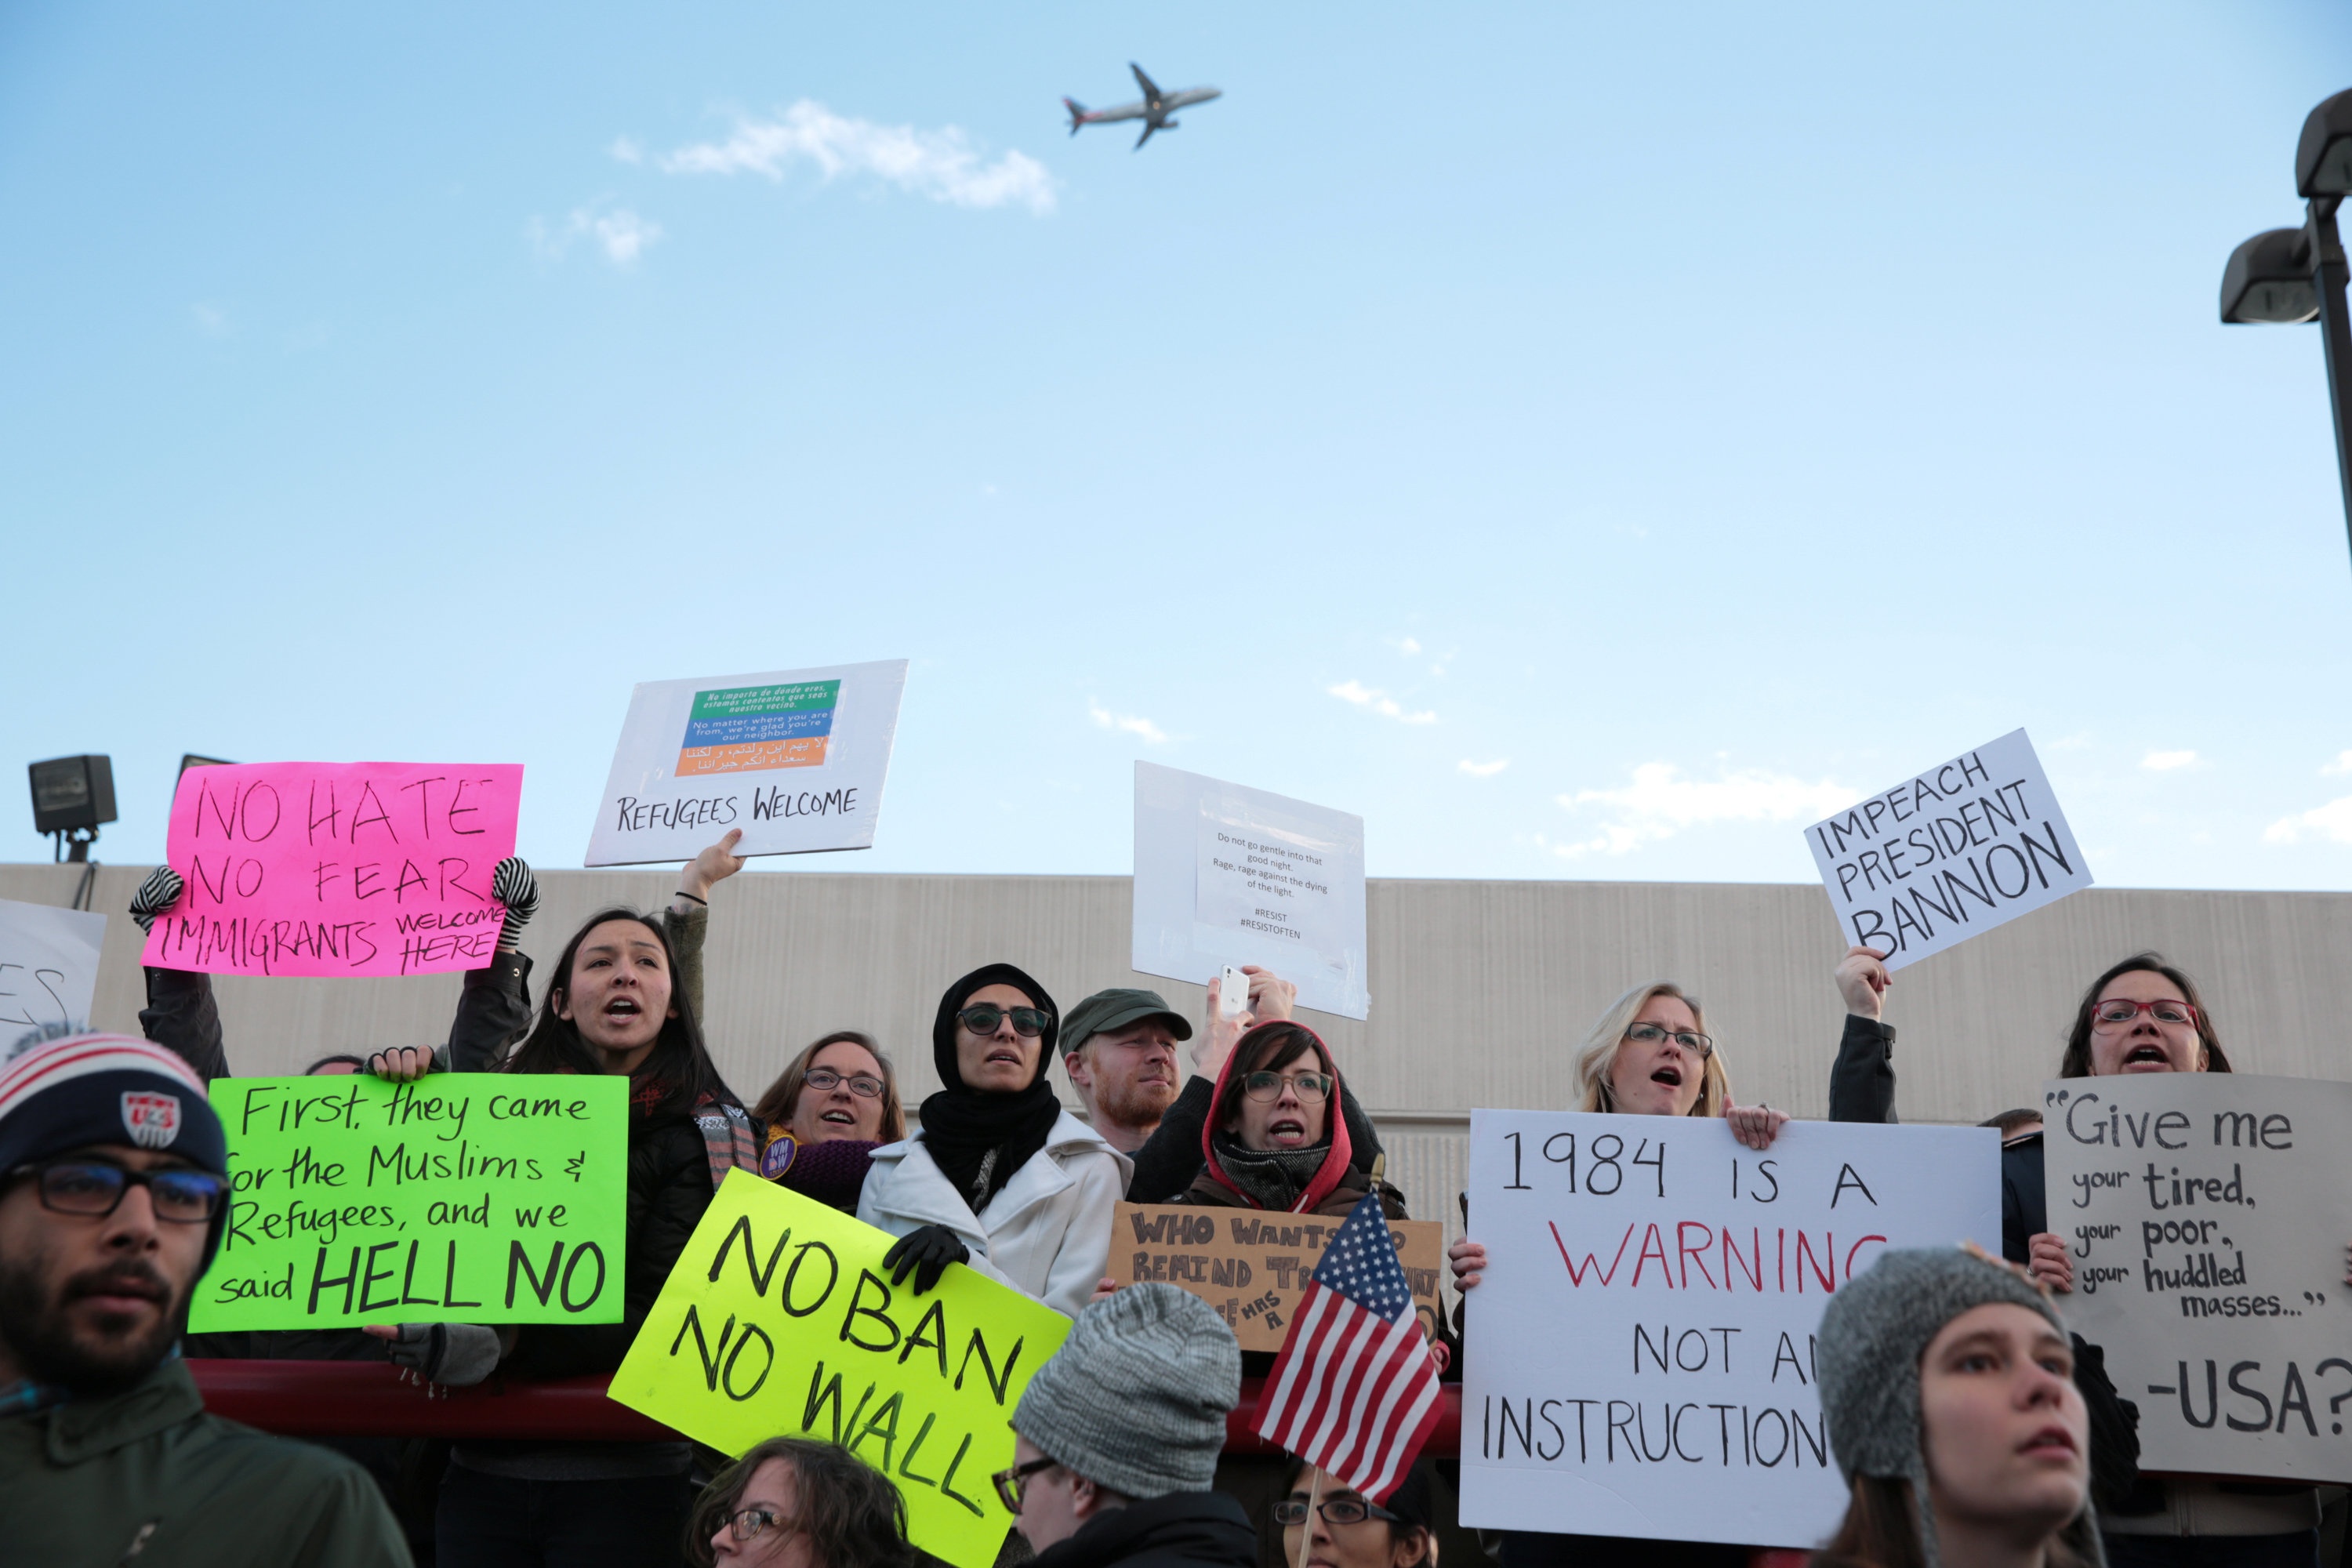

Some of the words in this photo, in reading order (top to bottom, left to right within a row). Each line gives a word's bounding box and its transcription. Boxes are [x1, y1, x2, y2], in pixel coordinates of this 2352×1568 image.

[707, 692, 719, 702] No
[722, 691, 757, 700] importa
[760, 688, 771, 697] de
[729, 704, 763, 713] nuestro
[742, 693, 785, 706] contentos
[789, 693, 805, 702] que
[808, 691, 828, 699] seas
[693, 721, 708, 730] No
[713, 718, 747, 728] matter
[752, 714, 784, 724] where
[787, 713, 807, 722] you
[722, 733, 740, 742] our
[744, 729, 795, 740] neighbor.
[728, 724, 757, 733] we're
[761, 721, 784, 732] glad
[788, 719, 822, 731] you're
[814, 737, 825, 749] لا
[196, 778, 280, 842] NO
[309, 778, 492, 845] HATE
[618, 797, 738, 831] REFUGEES
[753, 786, 858, 820] WELCOME
[1817, 752, 1989, 859] IMPEACH
[1218, 833, 1229, 842] Do
[1232, 838, 1246, 847] not
[1260, 844, 1285, 856] gentle
[1287, 850, 1304, 861] into
[1305, 855, 1322, 866] that
[1836, 779, 2030, 903] PRESIDENT
[191, 855, 263, 908] NO
[314, 858, 485, 902] FEAR
[1214, 858, 1236, 871] Rage,
[1238, 866, 1256, 876] rage
[1259, 870, 1287, 883] against
[1290, 877, 1303, 887] the
[1305, 880, 1327, 895] dying
[1247, 855, 1268, 865] good
[1271, 860, 1294, 871] night.
[1247, 880, 1256, 888] of
[1258, 884, 1272, 892] the
[1274, 885, 1294, 898] light.
[1852, 821, 2074, 961] BANNON
[1240, 918, 1301, 939] #RESISTOFTEN
[1255, 908, 1287, 922] #RESIST
[162, 916, 377, 975] IMMIGRANTS
[396, 907, 505, 934] WELCOME
[400, 931, 494, 975] HERE
[242, 1084, 368, 1135] First,
[384, 1084, 468, 1141] they
[489, 1096, 591, 1120] came
[2214, 1111, 2293, 1150] me
[283, 1146, 347, 1189] the
[367, 1141, 543, 1187] Muslims
[564, 1151, 585, 1182] &
[1502, 1132, 1666, 1197] 1984
[1733, 1158, 1779, 1203] IS
[1831, 1163, 1878, 1208] A
[2072, 1169, 2130, 1207] your
[2143, 1163, 2256, 1210] tired,
[227, 1201, 406, 1250] Refugees,
[428, 1193, 488, 1228] and
[515, 1203, 568, 1228] we
[1131, 1212, 1214, 1245] WHO
[2074, 1222, 2121, 1258] your
[2142, 1218, 2233, 1258] poor,
[215, 1263, 293, 1303] said
[307, 1239, 481, 1314] HELL
[505, 1240, 605, 1312] NO
[1133, 1251, 1252, 1287] REMIND
[2082, 1265, 2129, 1294] your
[2143, 1251, 2247, 1292] huddled
[708, 1215, 838, 1317] NO
[839, 1268, 1024, 1406] BAN
[1241, 1290, 1281, 1319] HAS
[1265, 1313, 1284, 1330] A
[1634, 1323, 1741, 1374] NOT
[670, 1305, 774, 1401] NO
[801, 1360, 985, 1517] WALL
[1483, 1395, 1828, 1468] INSTRUCTION
